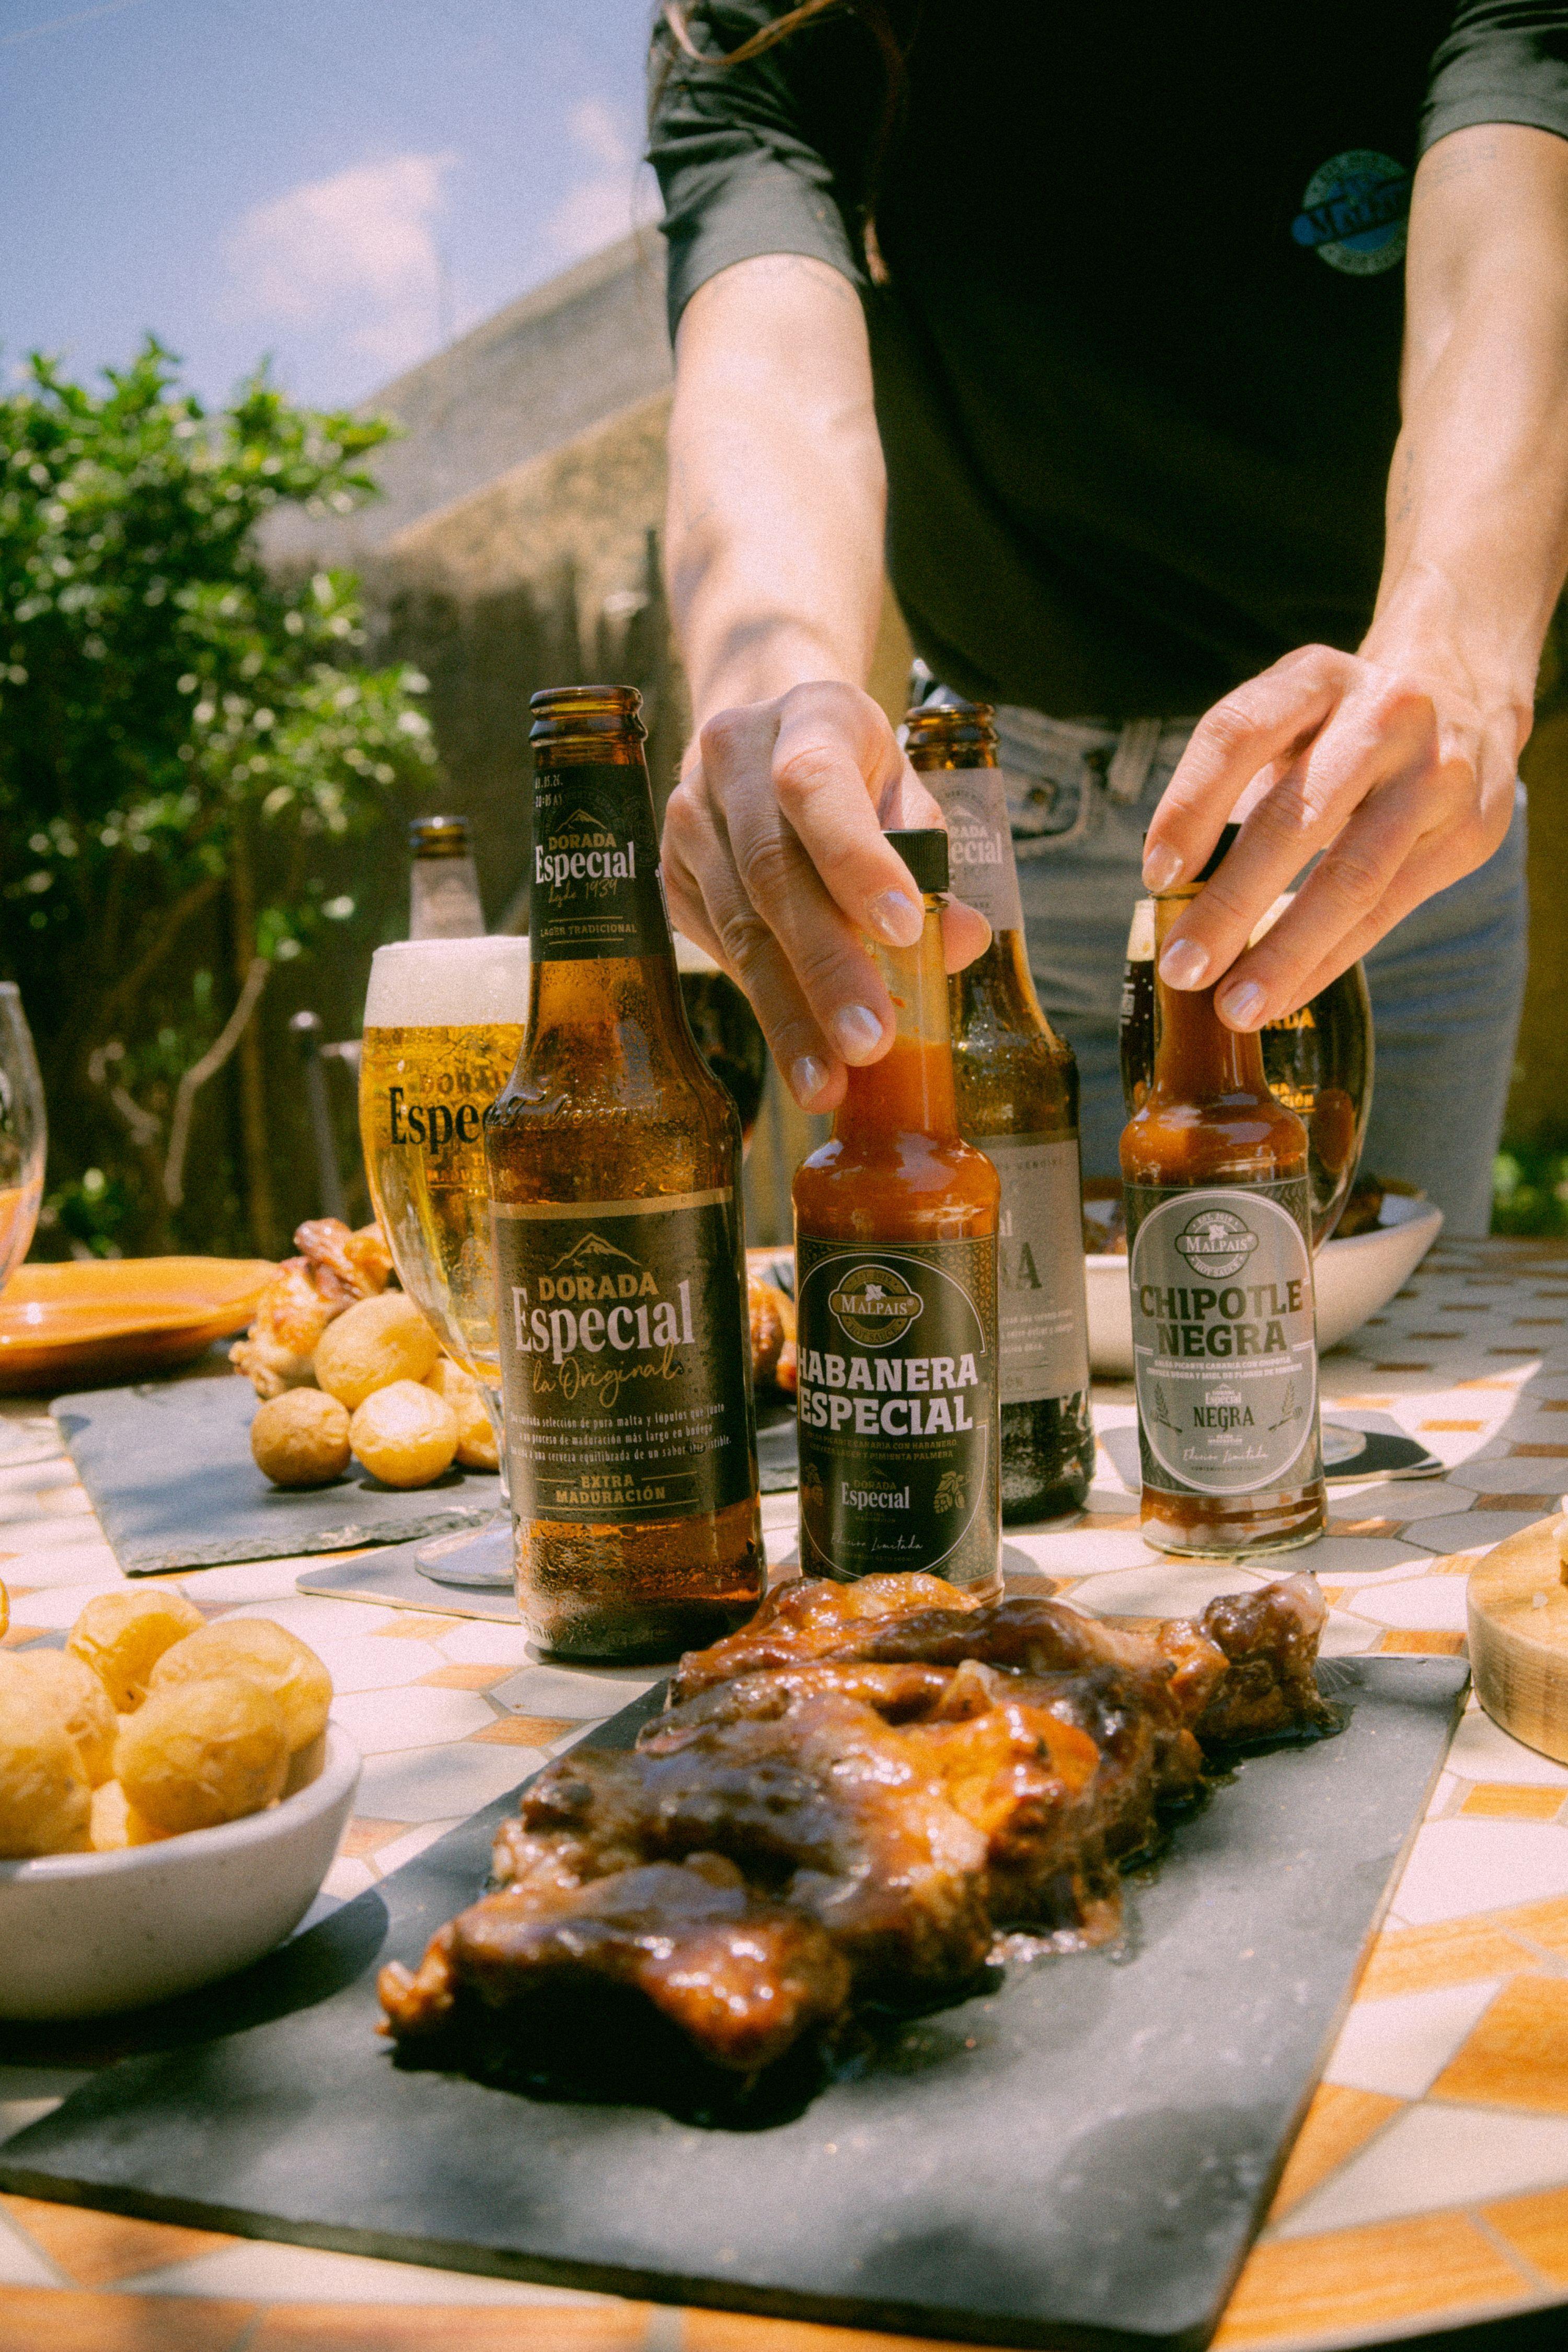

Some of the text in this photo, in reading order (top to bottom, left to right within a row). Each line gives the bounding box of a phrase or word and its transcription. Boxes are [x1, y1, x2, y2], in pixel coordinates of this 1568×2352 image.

[549, 833, 617, 851] DORADA
[951, 832, 1003, 864] ecial
[536, 841, 637, 887] Especial
[540, 923, 637, 937] LAGER TRADICIONAL
[389, 1087, 493, 1155] Espe
[1185, 1236, 1248, 1253] MALPAIS
[539, 1271, 659, 1301] DORADA
[840, 1295, 908, 1315] MALPAIS
[1139, 1279, 1304, 1321] CHIPOTLE
[511, 1279, 696, 1365] Especial
[1157, 1320, 1287, 1357] NEGRA
[533, 1336, 681, 1408] la Original
[799, 1347, 978, 1392] HABANERA
[543, 1416, 577, 1428] selección
[580, 1417, 590, 1428] de
[594, 1419, 613, 1430] pura
[617, 1415, 642, 1427] malta
[647, 1416, 651, 1427] y
[655, 1410, 687, 1425] lúpulos
[690, 1408, 704, 1422] que
[800, 1386, 972, 1436] ESPECIAL
[1193, 1405, 1255, 1432] NEGRA
[532, 1434, 557, 1445] proceso
[560, 1434, 569, 1445] de
[572, 1434, 621, 1445] maduración
[626, 1433, 642, 1444] más
[646, 1430, 668, 1443] largo
[673, 1429, 682, 1438] en
[686, 1424, 712, 1437] bodega
[913, 1439, 957, 1449] HABANERO
[549, 1452, 576, 1462] cerveza
[579, 1450, 630, 1465] equilibrada
[635, 1449, 644, 1460] de
[648, 1450, 659, 1459] un
[663, 1445, 685, 1457] sabor
[914, 1450, 953, 1460] PALMERA
[581, 1474, 635, 1488] EXTRA
[854, 1480, 896, 1490] DORADA
[556, 1486, 666, 1504] MADURACIÓN
[841, 1481, 910, 1511] Especial
